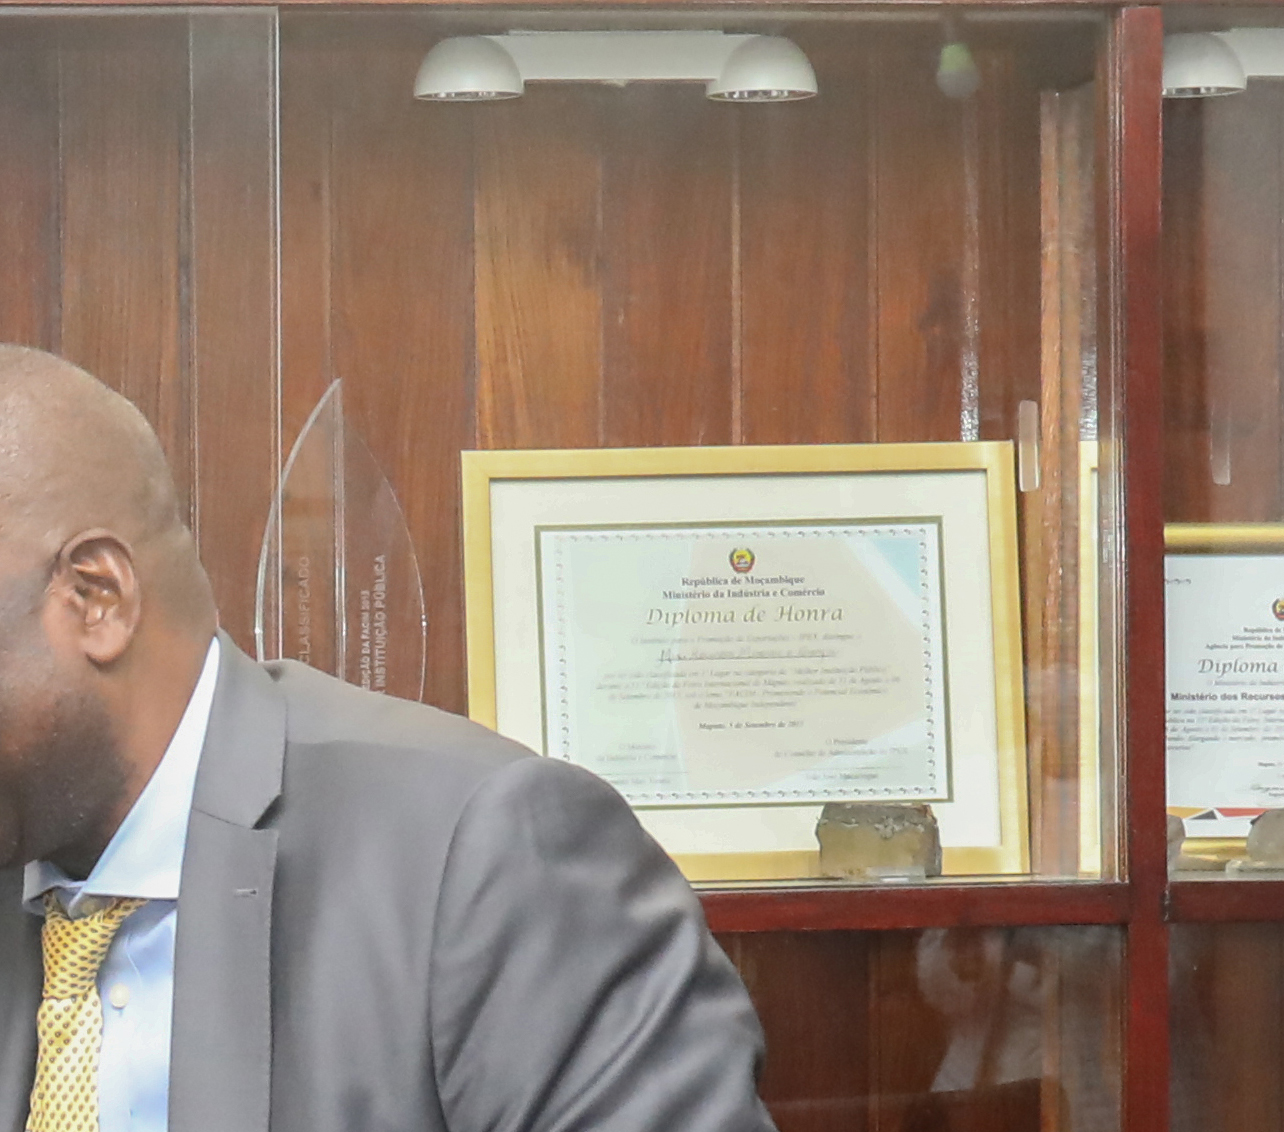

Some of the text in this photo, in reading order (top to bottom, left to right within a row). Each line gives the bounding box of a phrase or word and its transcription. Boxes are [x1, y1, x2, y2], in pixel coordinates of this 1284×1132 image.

[373, 554, 386, 608] PÚBLICA
[681, 575, 805, 587] República de Moçambique
[662, 588, 710, 599] Ministério
[713, 589, 725, 598] da
[727, 587, 770, 598] Indústria
[780, 587, 825, 597] Comércio
[646, 605, 844, 627] Diploma de Honra
[374, 611, 388, 687] INSTITUIÇÃO
[1198, 657, 1278, 678] Diploma
[1171, 692, 1217, 700] Ministério
[1220, 692, 1238, 700] dos
